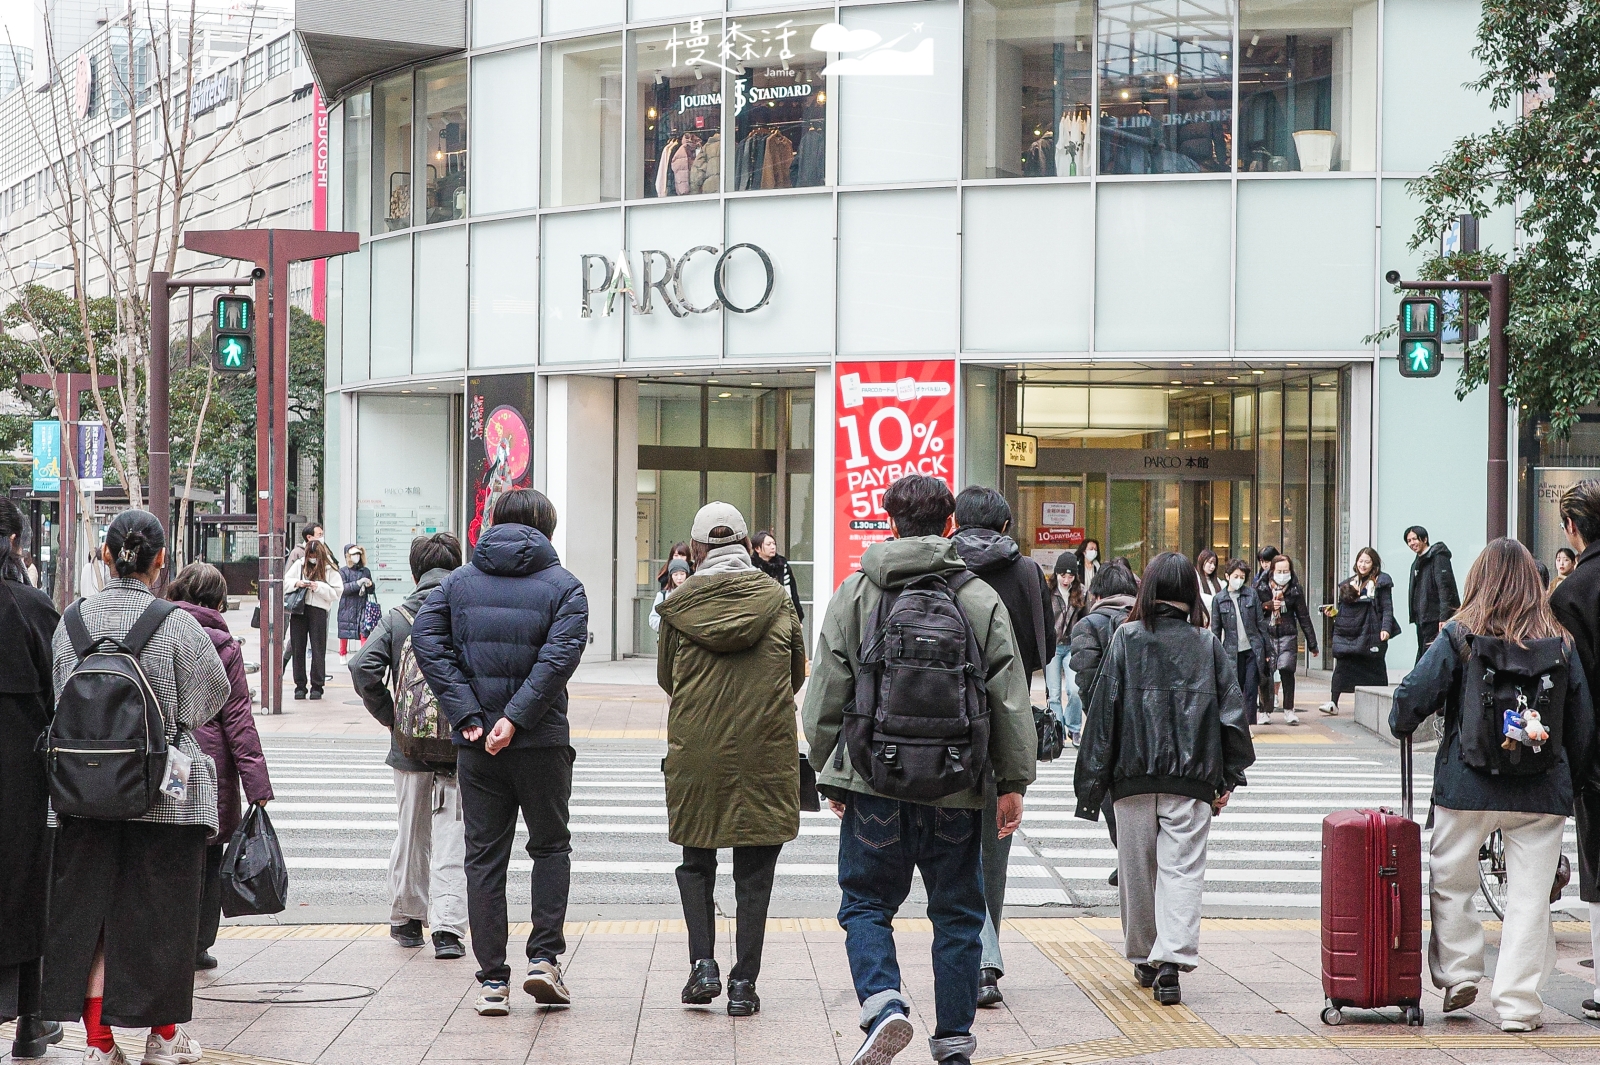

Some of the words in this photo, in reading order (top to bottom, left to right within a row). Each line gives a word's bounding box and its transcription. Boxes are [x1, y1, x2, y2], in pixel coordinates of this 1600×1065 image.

[678, 94, 723, 115] JOURNA
[749, 83, 812, 103] STANDARD
[580, 242, 776, 318] PARCO
[839, 406, 944, 469] 10%
[1010, 439, 1027, 453] 天神駅
[847, 454, 949, 491] PAYBACK
[1144, 456, 1182, 469] PARCO
[1185, 456, 1210, 469] 本館
[405, 486, 421, 495] 本館
